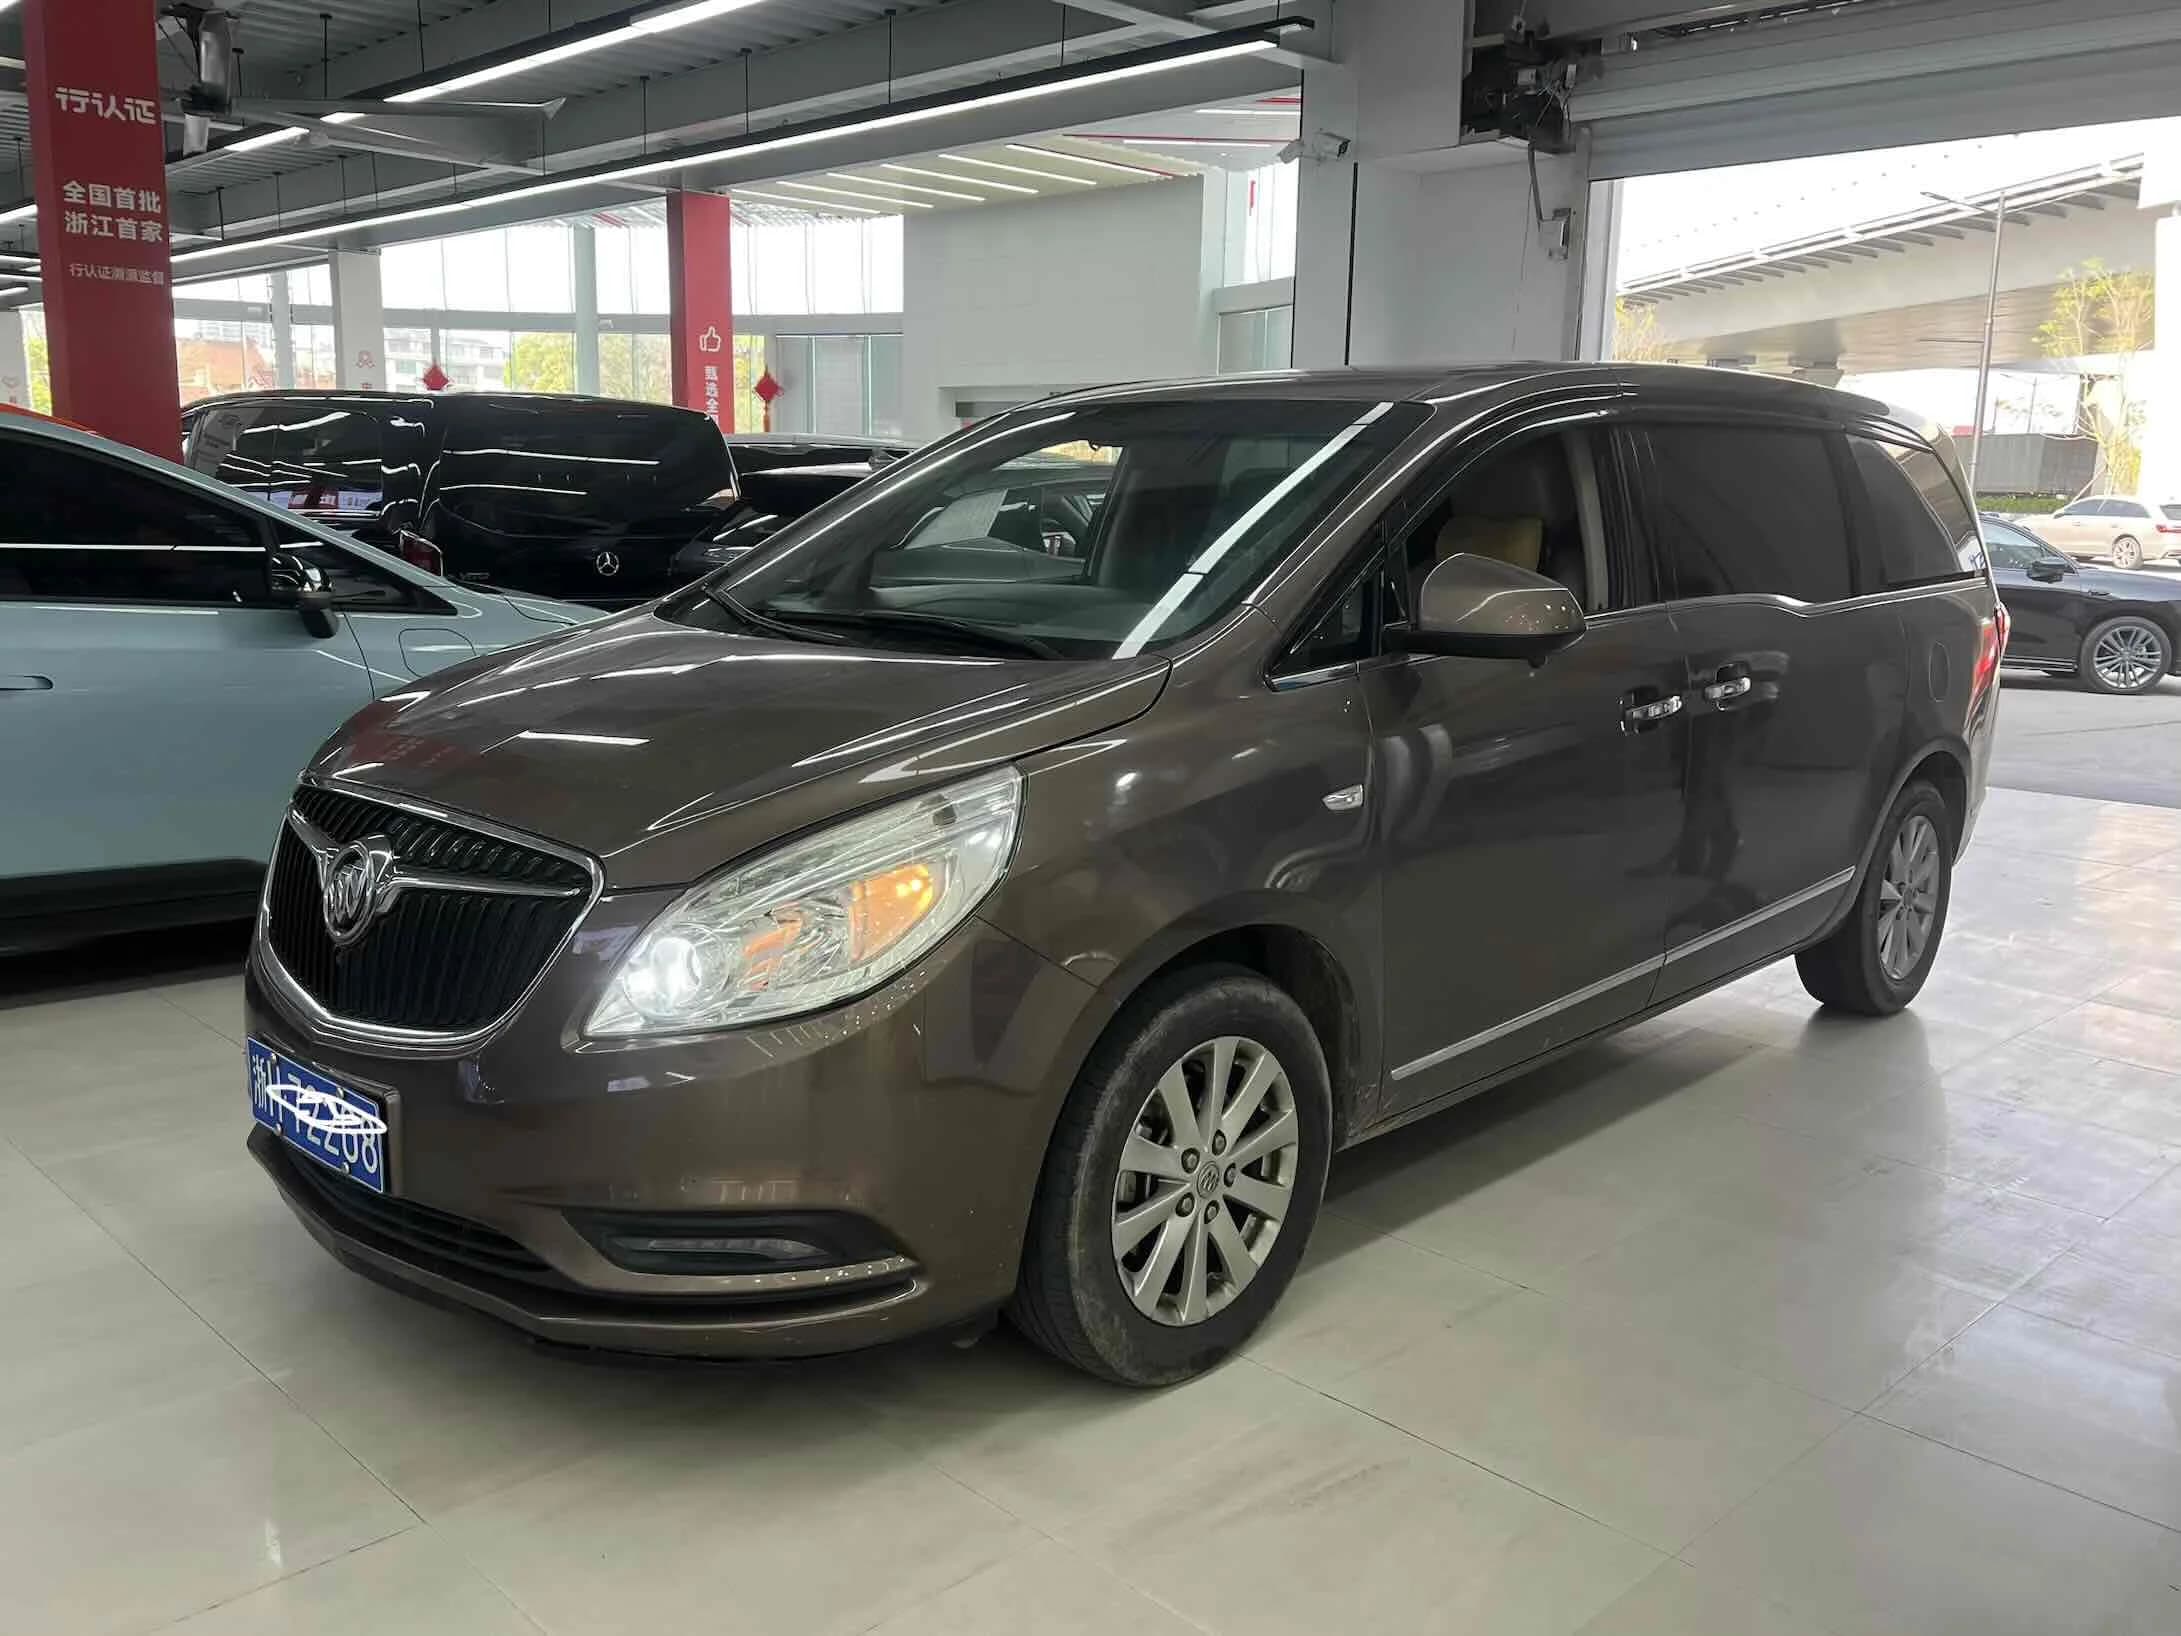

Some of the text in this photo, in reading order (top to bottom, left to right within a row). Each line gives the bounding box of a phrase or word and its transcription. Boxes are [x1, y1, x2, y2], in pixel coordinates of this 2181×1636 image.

[55, 86, 157, 125] 行认证
[62, 180, 161, 213] 全国首批
[63, 210, 163, 243] 浙江首家
